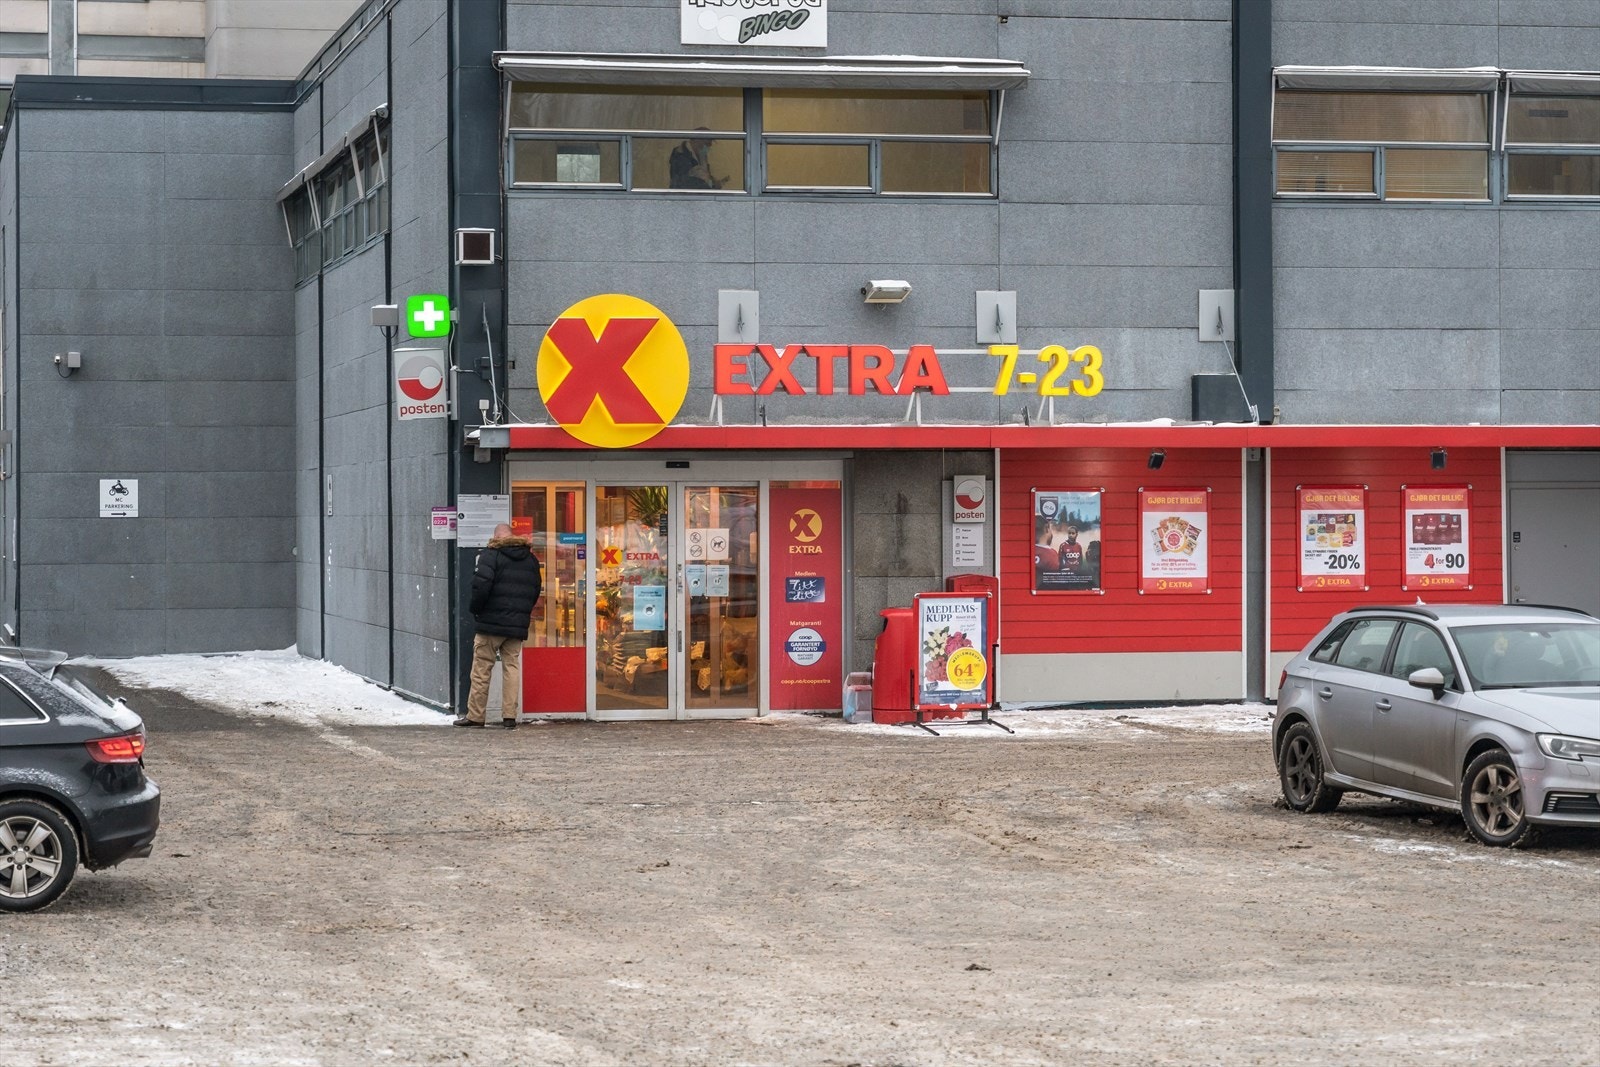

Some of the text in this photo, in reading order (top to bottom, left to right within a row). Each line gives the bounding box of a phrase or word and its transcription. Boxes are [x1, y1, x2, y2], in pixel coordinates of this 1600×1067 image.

[738, 9, 810, 43] BINGO
[714, 343, 950, 396] EXTRA
[988, 345, 1104, 397] 7-23
[400, 403, 445, 417] posten
[955, 511, 985, 520] posten
[1324, 554, 1360, 569] -20%
[1424, 554, 1435, 568] 4
[1446, 554, 1464, 568] 90
[926, 604, 978, 614] MEDLEMS-
[926, 614, 952, 622] KUPP
[954, 664, 974, 676] 64
